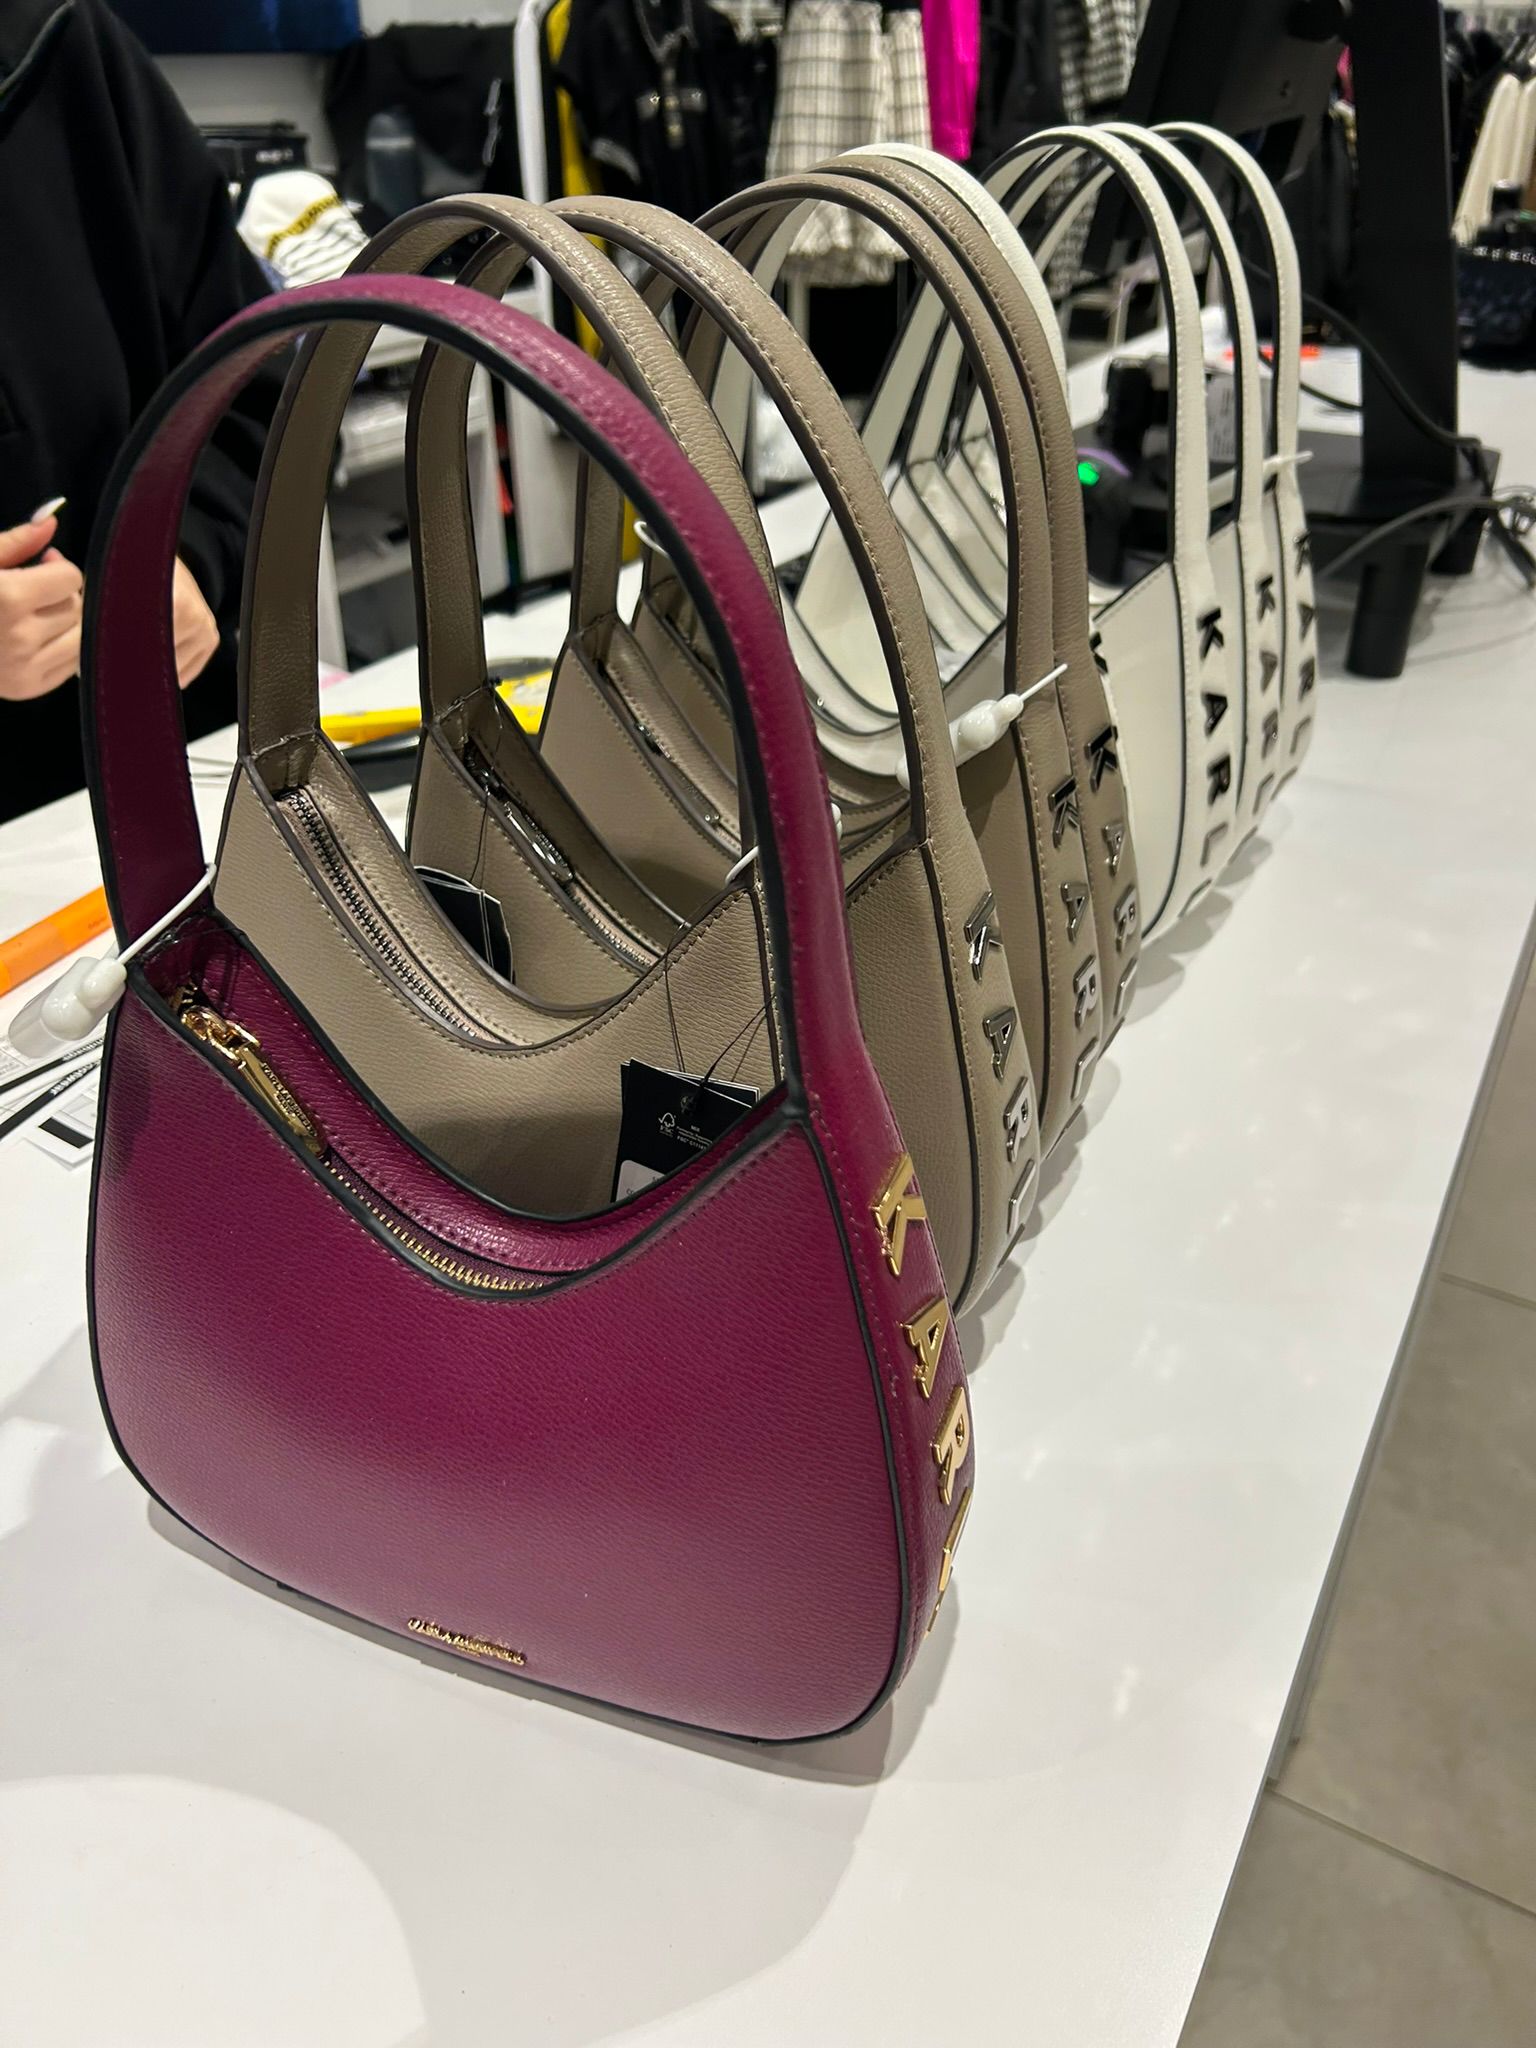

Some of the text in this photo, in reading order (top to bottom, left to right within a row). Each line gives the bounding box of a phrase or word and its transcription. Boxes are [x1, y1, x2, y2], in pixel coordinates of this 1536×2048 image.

[1196, 606, 1233, 868] KARL
[1255, 574, 1281, 817] KARL
[1289, 528, 1316, 757] KARL
[1047, 773, 1100, 1101] KARL
[1083, 723, 1139, 1018] KARL
[963, 890, 1038, 1238] KARL
[869, 1152, 974, 1594] KARL
